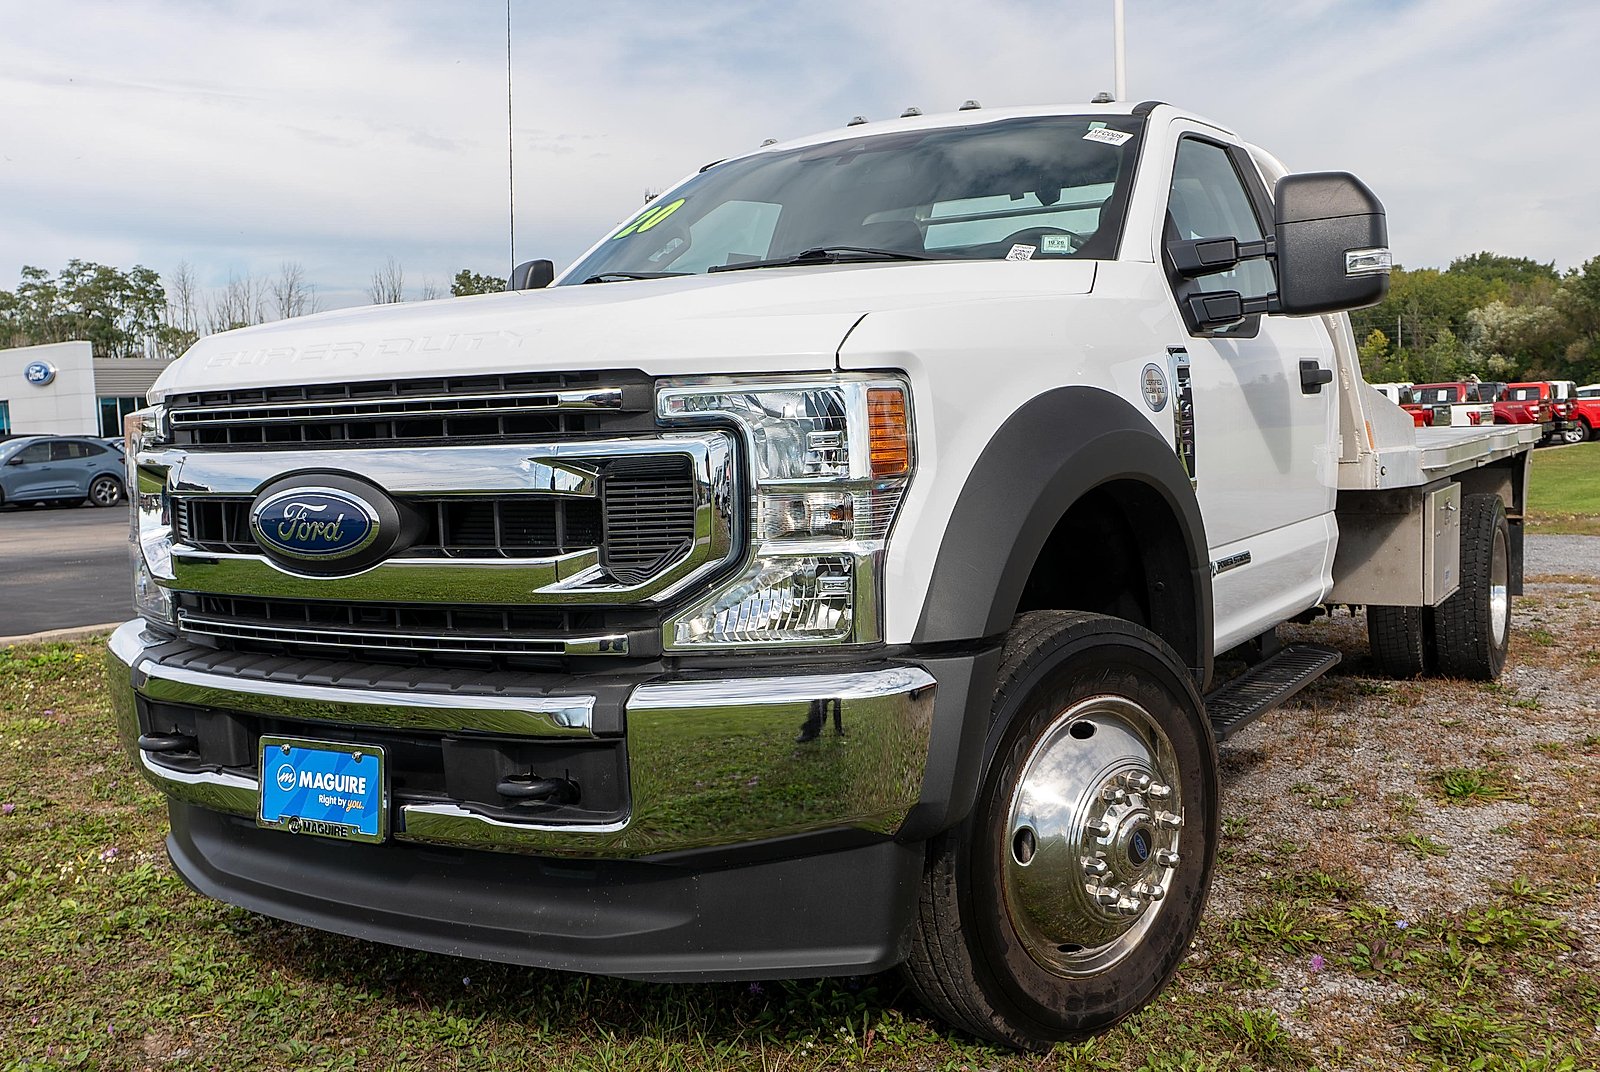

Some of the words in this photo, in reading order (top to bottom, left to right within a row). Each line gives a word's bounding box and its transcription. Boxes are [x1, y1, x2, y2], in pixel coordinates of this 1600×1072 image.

[204, 341, 367, 370] SUPER
[372, 327, 543, 358] DUTY
[28, 365, 45, 380] Ford
[277, 502, 344, 541] Ford
[299, 771, 366, 794] MAGUIRE
[318, 794, 337, 807] Right
[337, 798, 347, 808] by
[346, 801, 365, 812] you.
[302, 821, 348, 838] MAGUIRE
